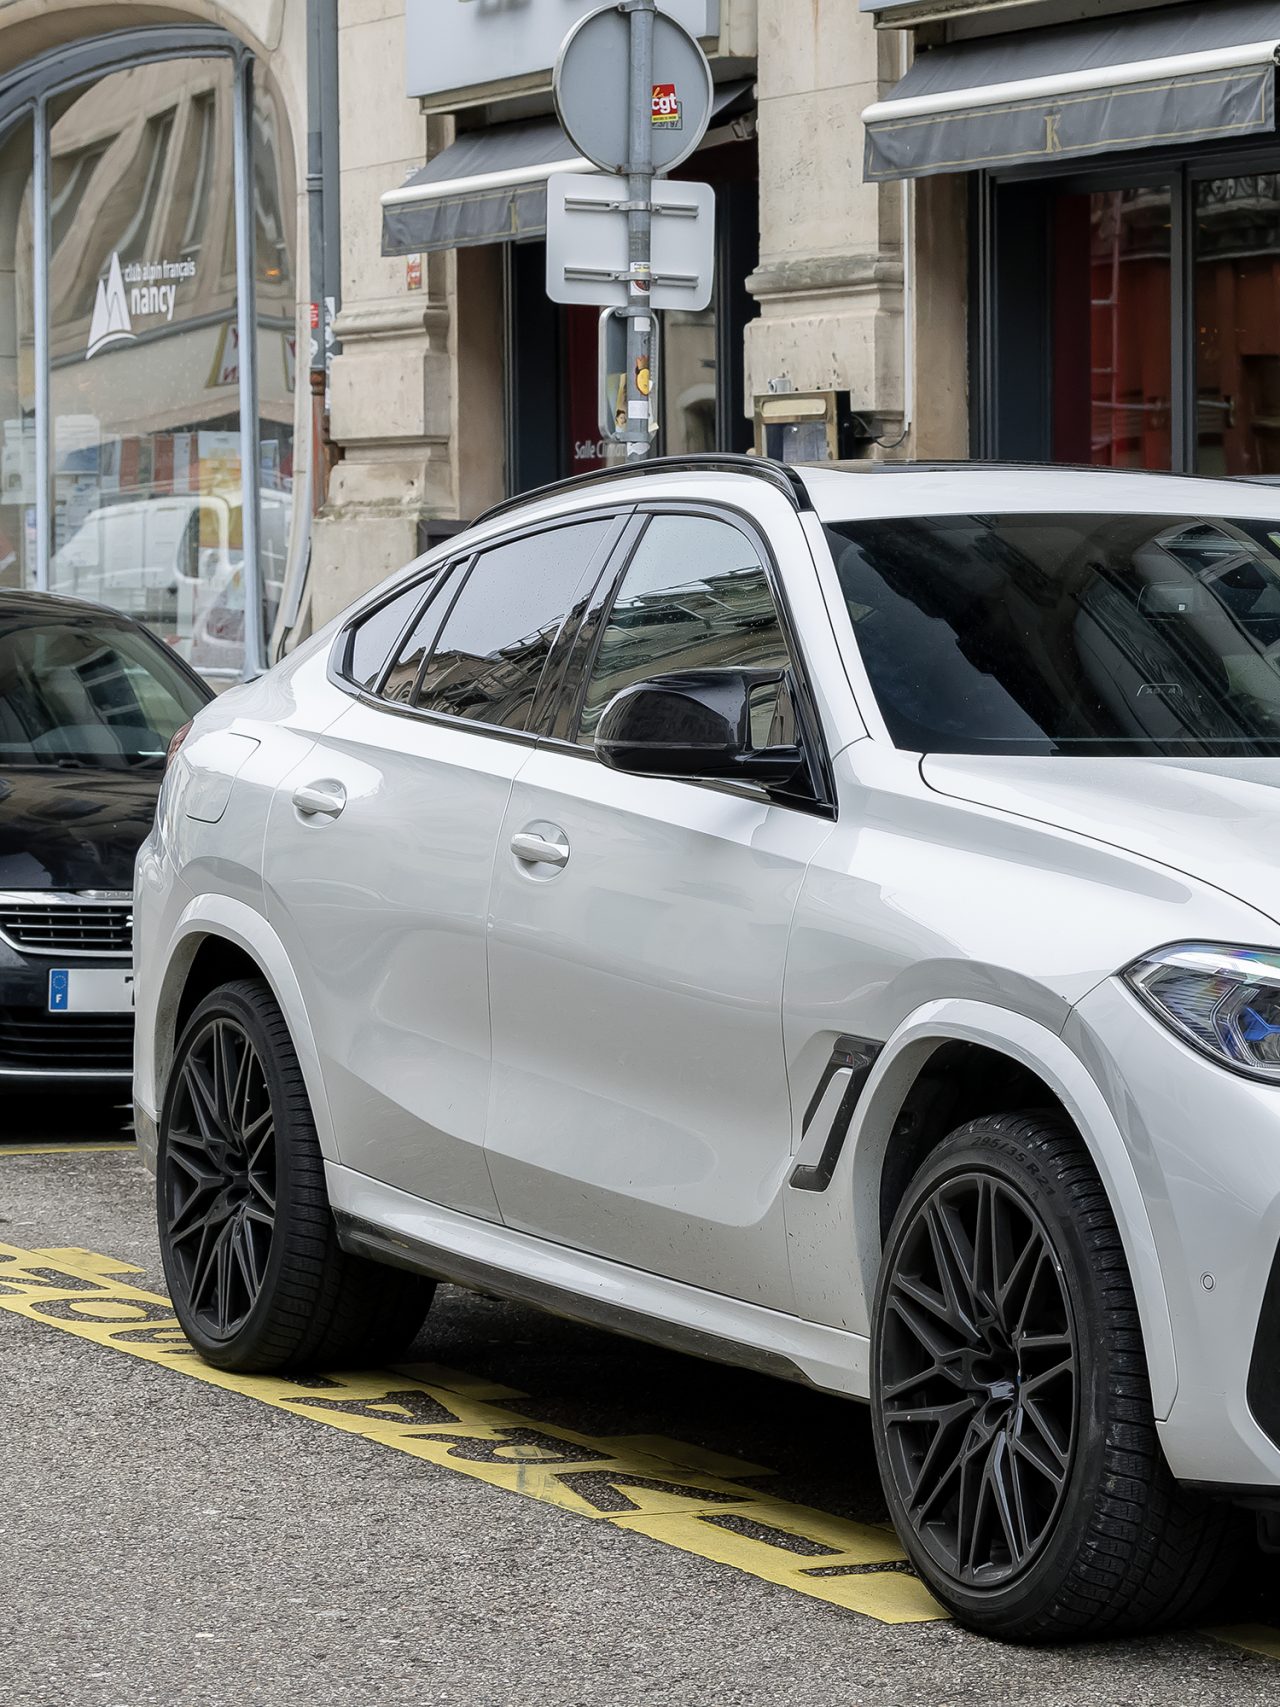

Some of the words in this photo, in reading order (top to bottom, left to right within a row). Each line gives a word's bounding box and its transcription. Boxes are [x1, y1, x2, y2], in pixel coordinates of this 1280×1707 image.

[652, 92, 678, 114] cgt
[131, 284, 176, 321] nancy
[574, 440, 595, 459] Salle
[56, 993, 63, 1004] F
